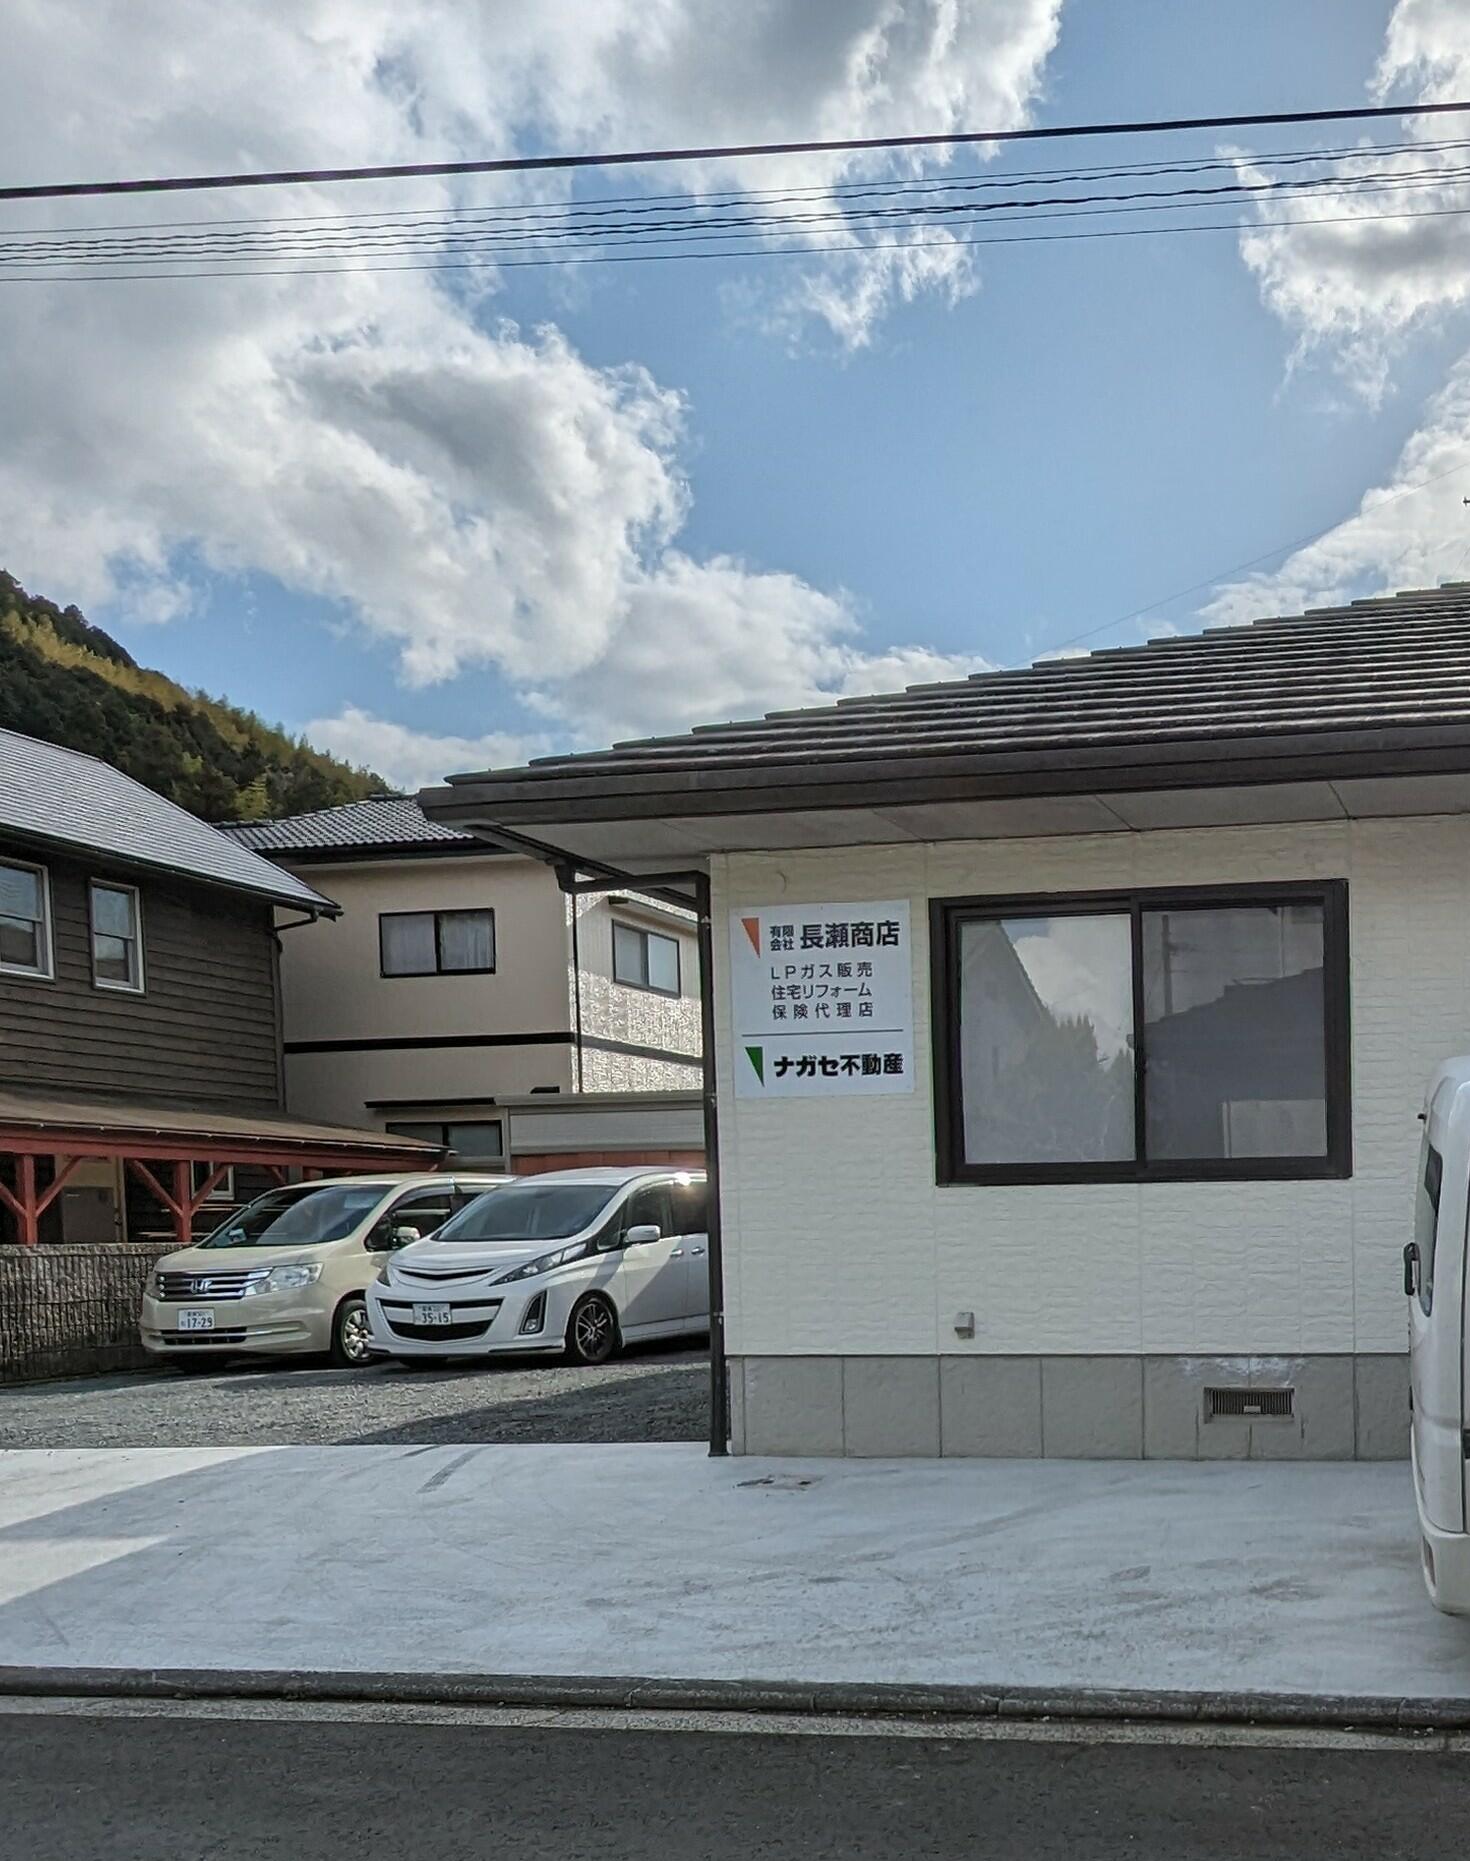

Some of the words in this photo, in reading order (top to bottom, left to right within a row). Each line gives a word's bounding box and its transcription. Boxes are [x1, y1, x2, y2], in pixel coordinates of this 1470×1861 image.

[770, 925, 794, 937] 有限
[800, 920, 900, 949] 長瀬商店
[770, 938, 794, 951] 会社
[771, 961, 873, 980] LPガス販売
[771, 982, 873, 1001] 住宅リフォーム
[772, 1002, 874, 1020] 保険代理店
[773, 1053, 904, 1078] ナガセ不動産
